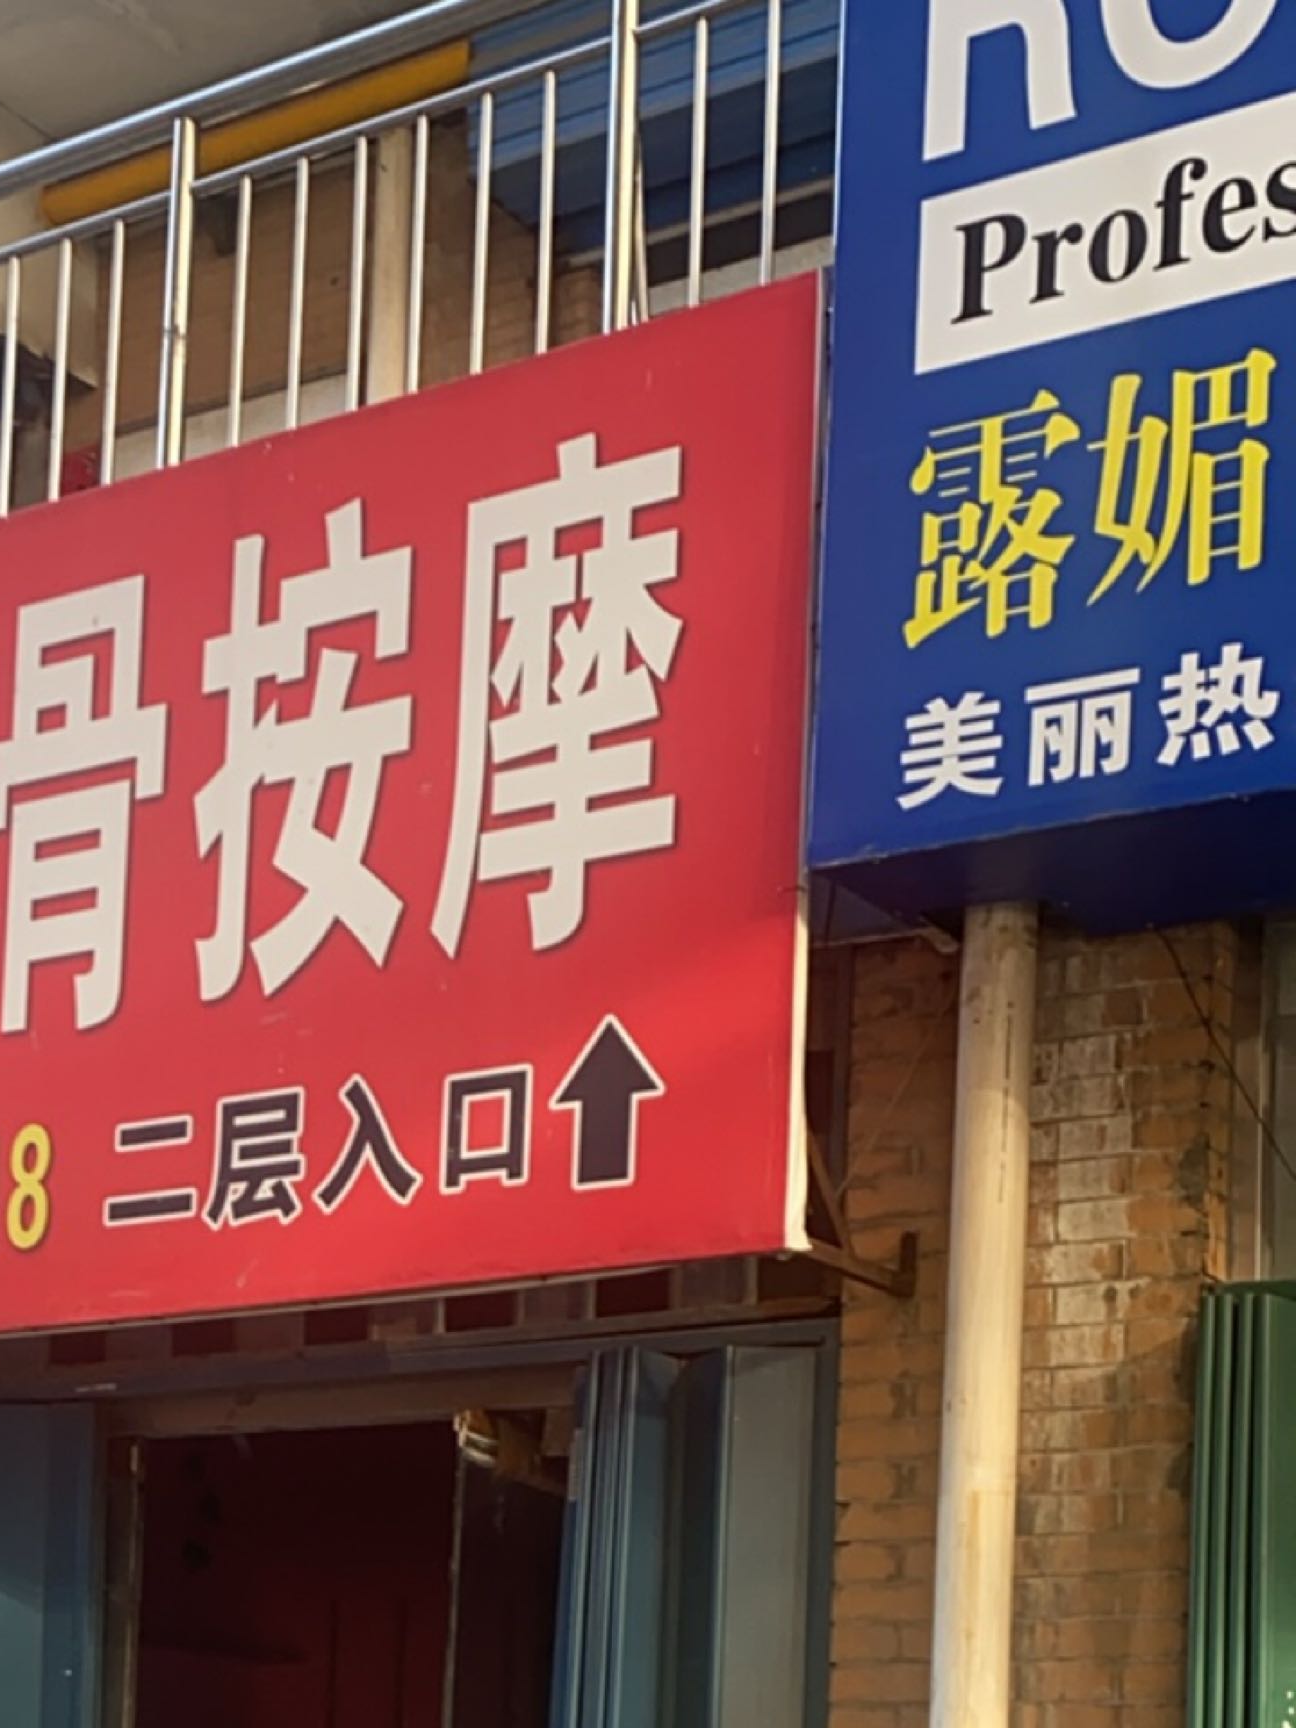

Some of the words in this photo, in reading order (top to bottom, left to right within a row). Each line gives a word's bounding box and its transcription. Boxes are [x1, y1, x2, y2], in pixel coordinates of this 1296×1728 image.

[950, 157, 1296, 326] Profes
[902, 346, 1277, 649] 露媚
[896, 641, 1281, 811] 美丽热
[103, 1063, 534, 1231] 二层入口
